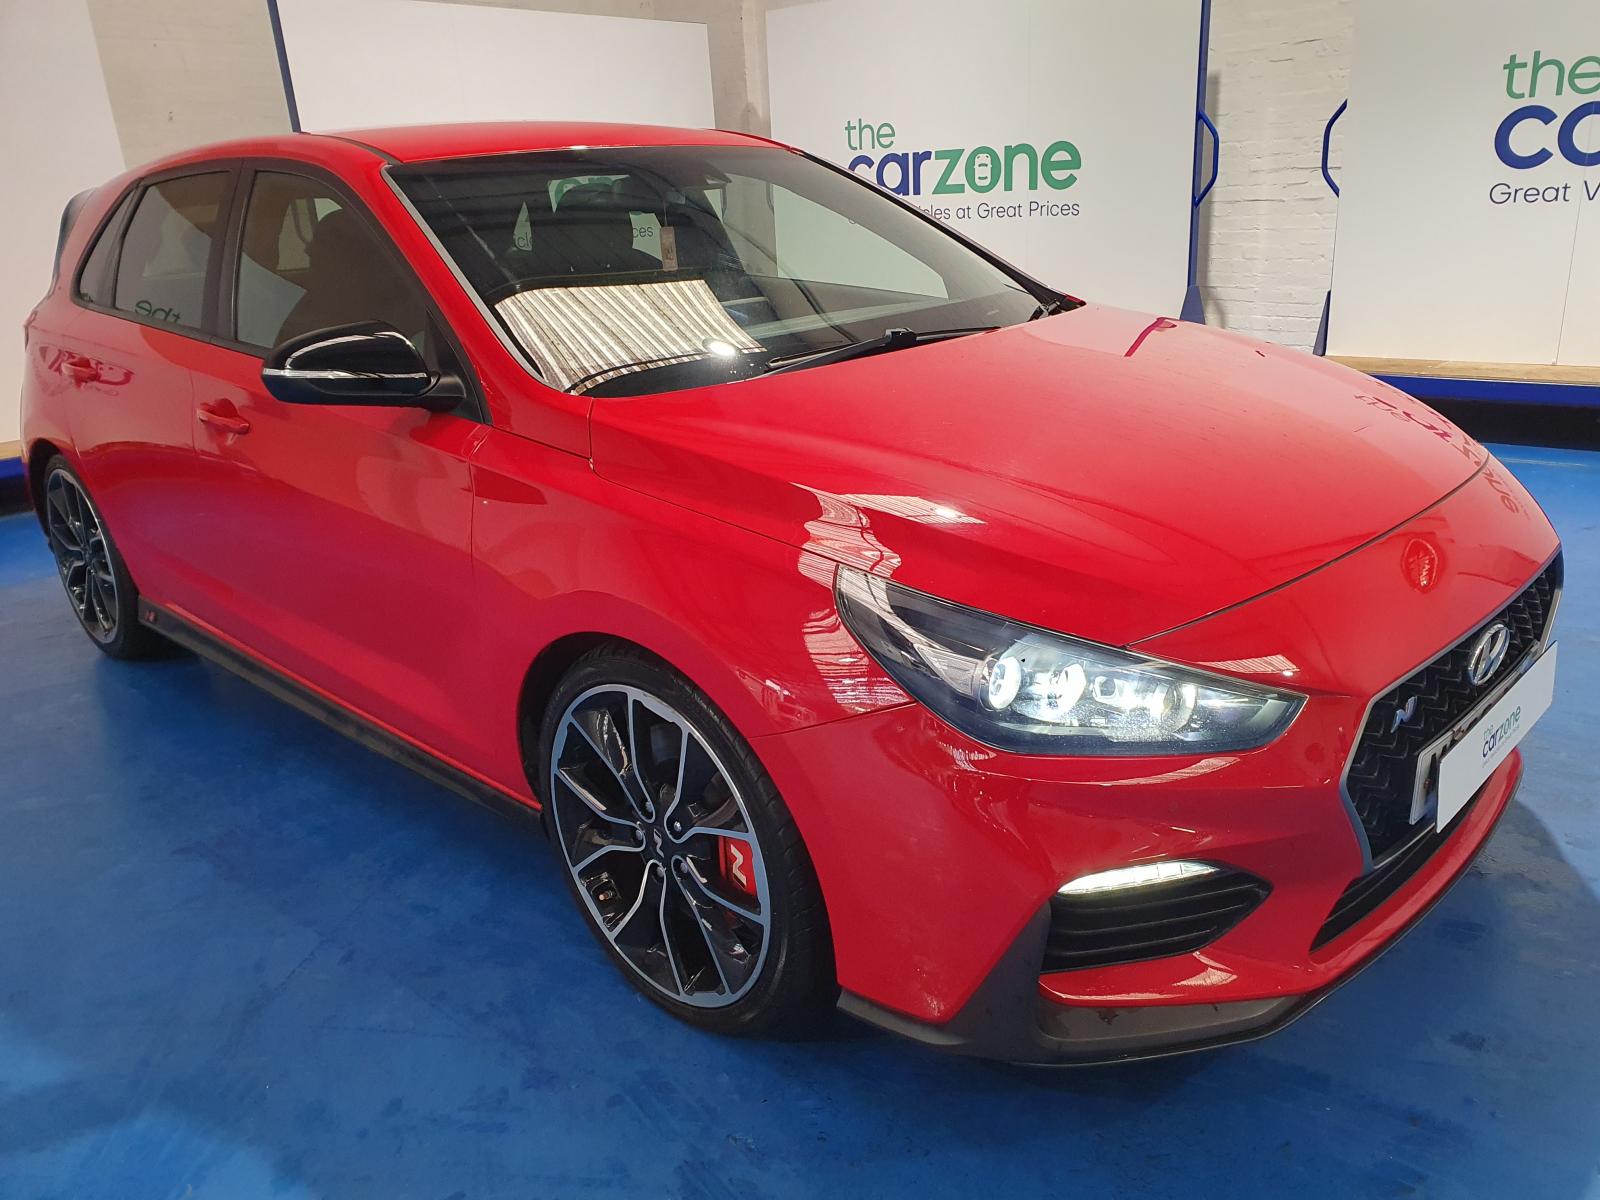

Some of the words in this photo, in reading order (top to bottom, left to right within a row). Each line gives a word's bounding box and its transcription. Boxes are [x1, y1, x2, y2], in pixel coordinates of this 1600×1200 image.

[1503, 50, 1600, 99] the
[845, 118, 896, 150] the
[956, 205, 971, 219] at
[977, 202, 1023, 219] Great
[1028, 199, 1080, 217] Prices
[1489, 182, 1571, 205] Great
[1482, 705, 1521, 758] carzone
